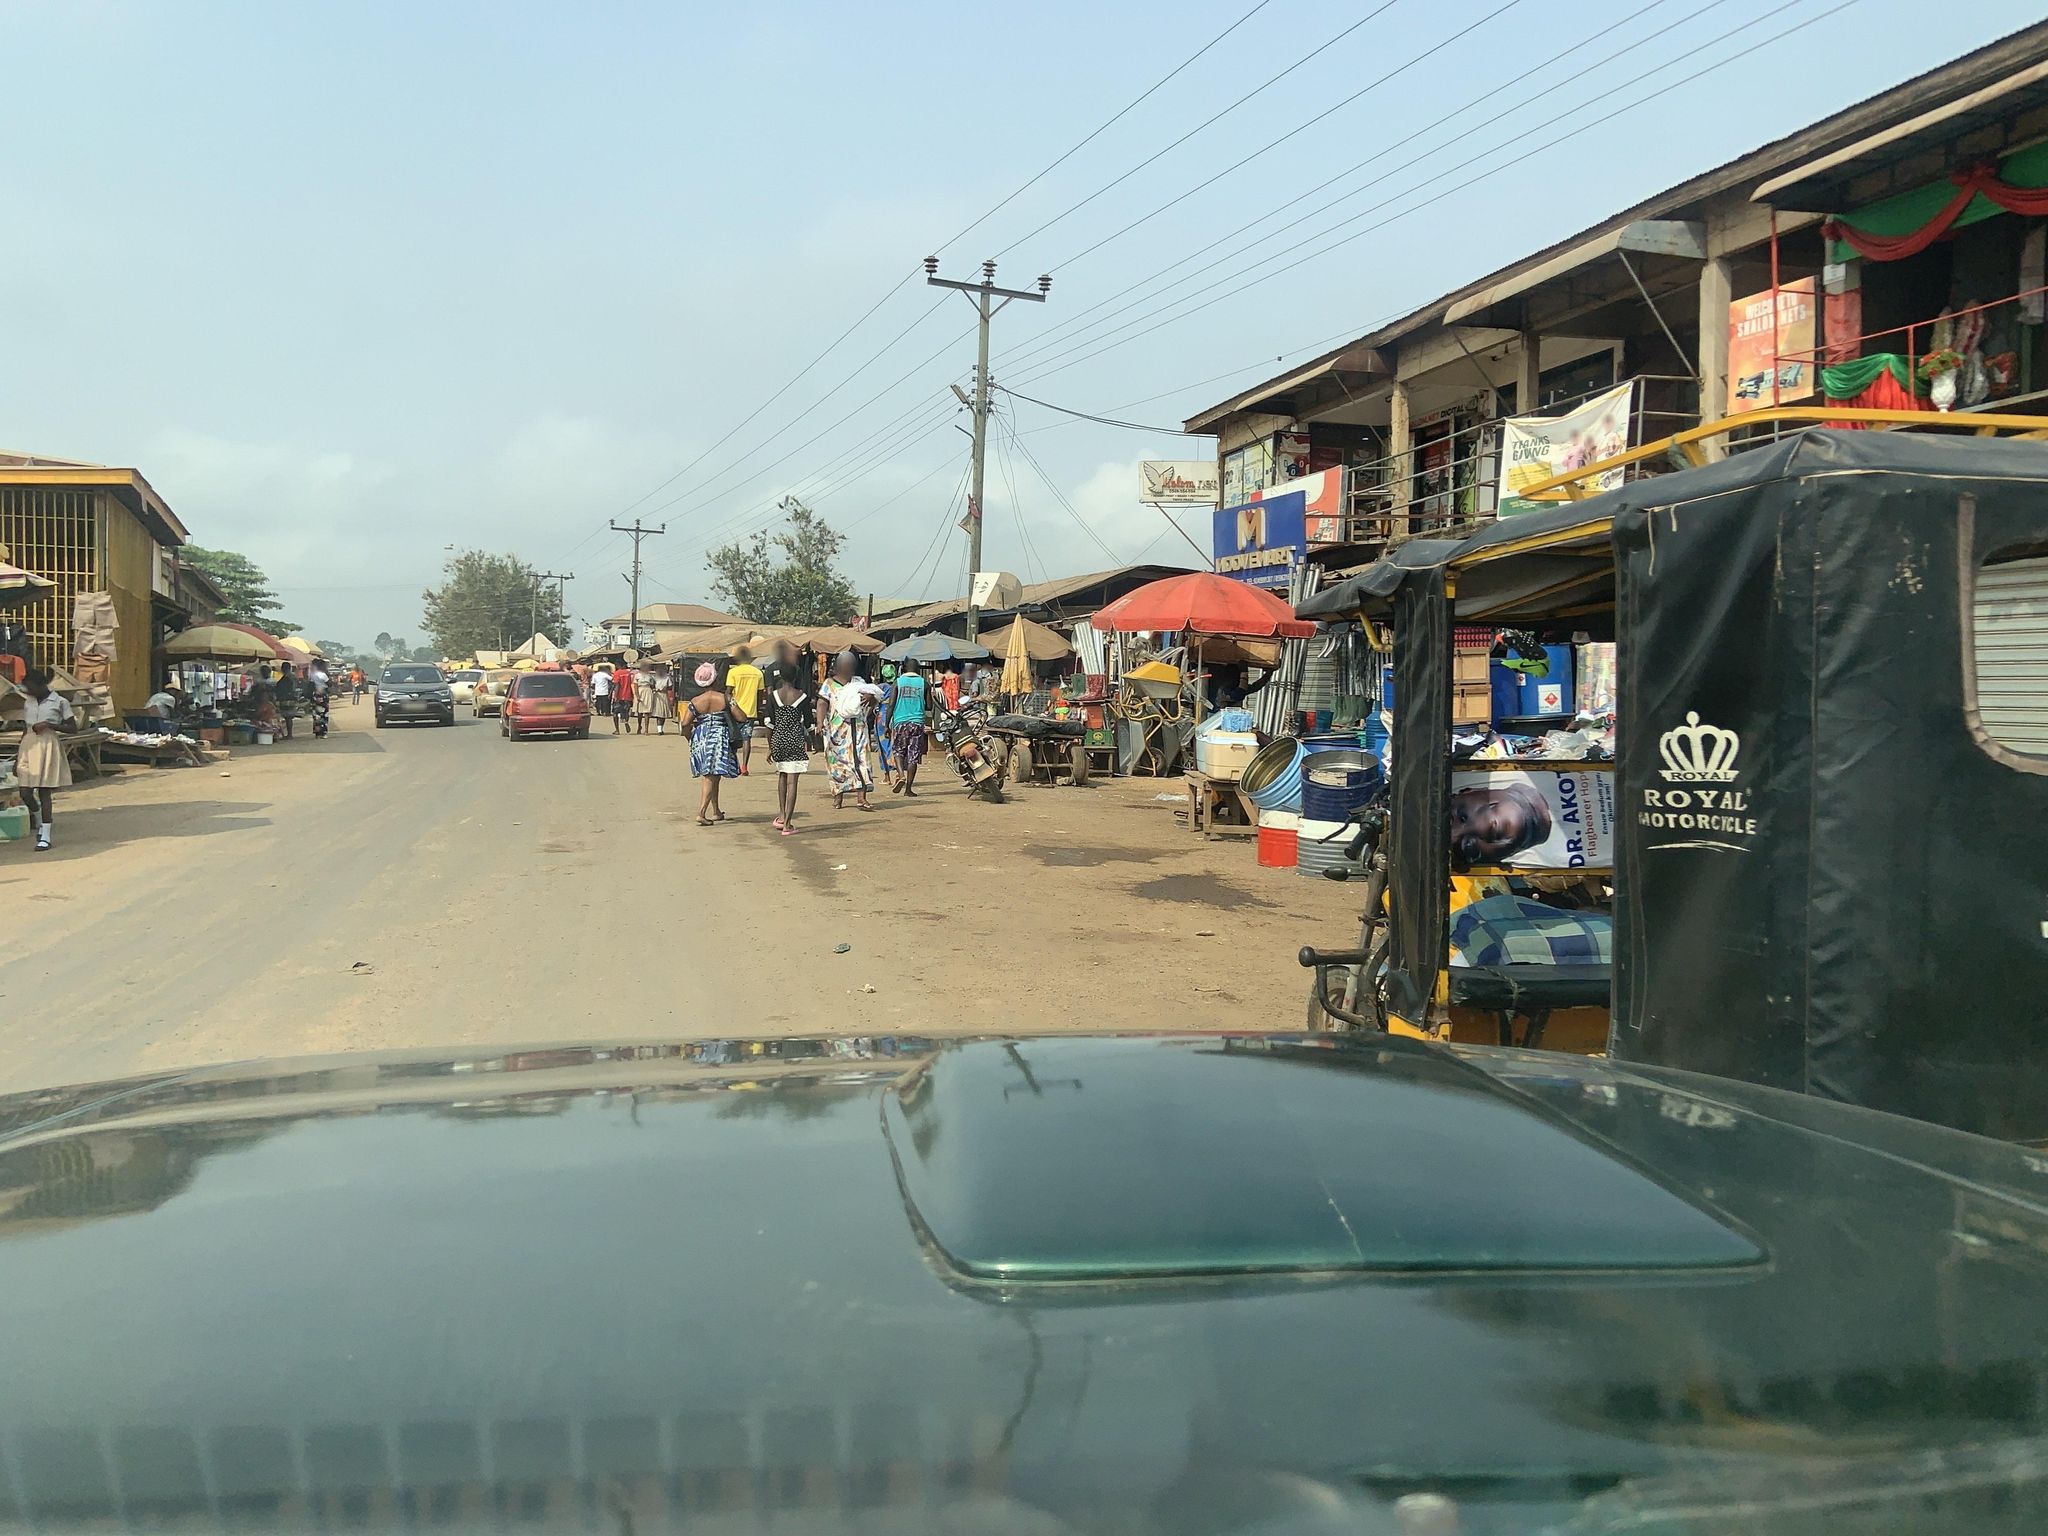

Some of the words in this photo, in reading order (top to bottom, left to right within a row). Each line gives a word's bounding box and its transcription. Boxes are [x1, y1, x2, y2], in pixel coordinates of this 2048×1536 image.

[1512, 435, 1551, 451] THANKS
[1215, 545, 1297, 573] MOOVEMART
[1670, 771, 1731, 781] ROYAL
[1644, 789, 1748, 811] ROYAL
[1583, 799, 1598, 857] Flagbearer
[1567, 830, 1585, 868] DR.
